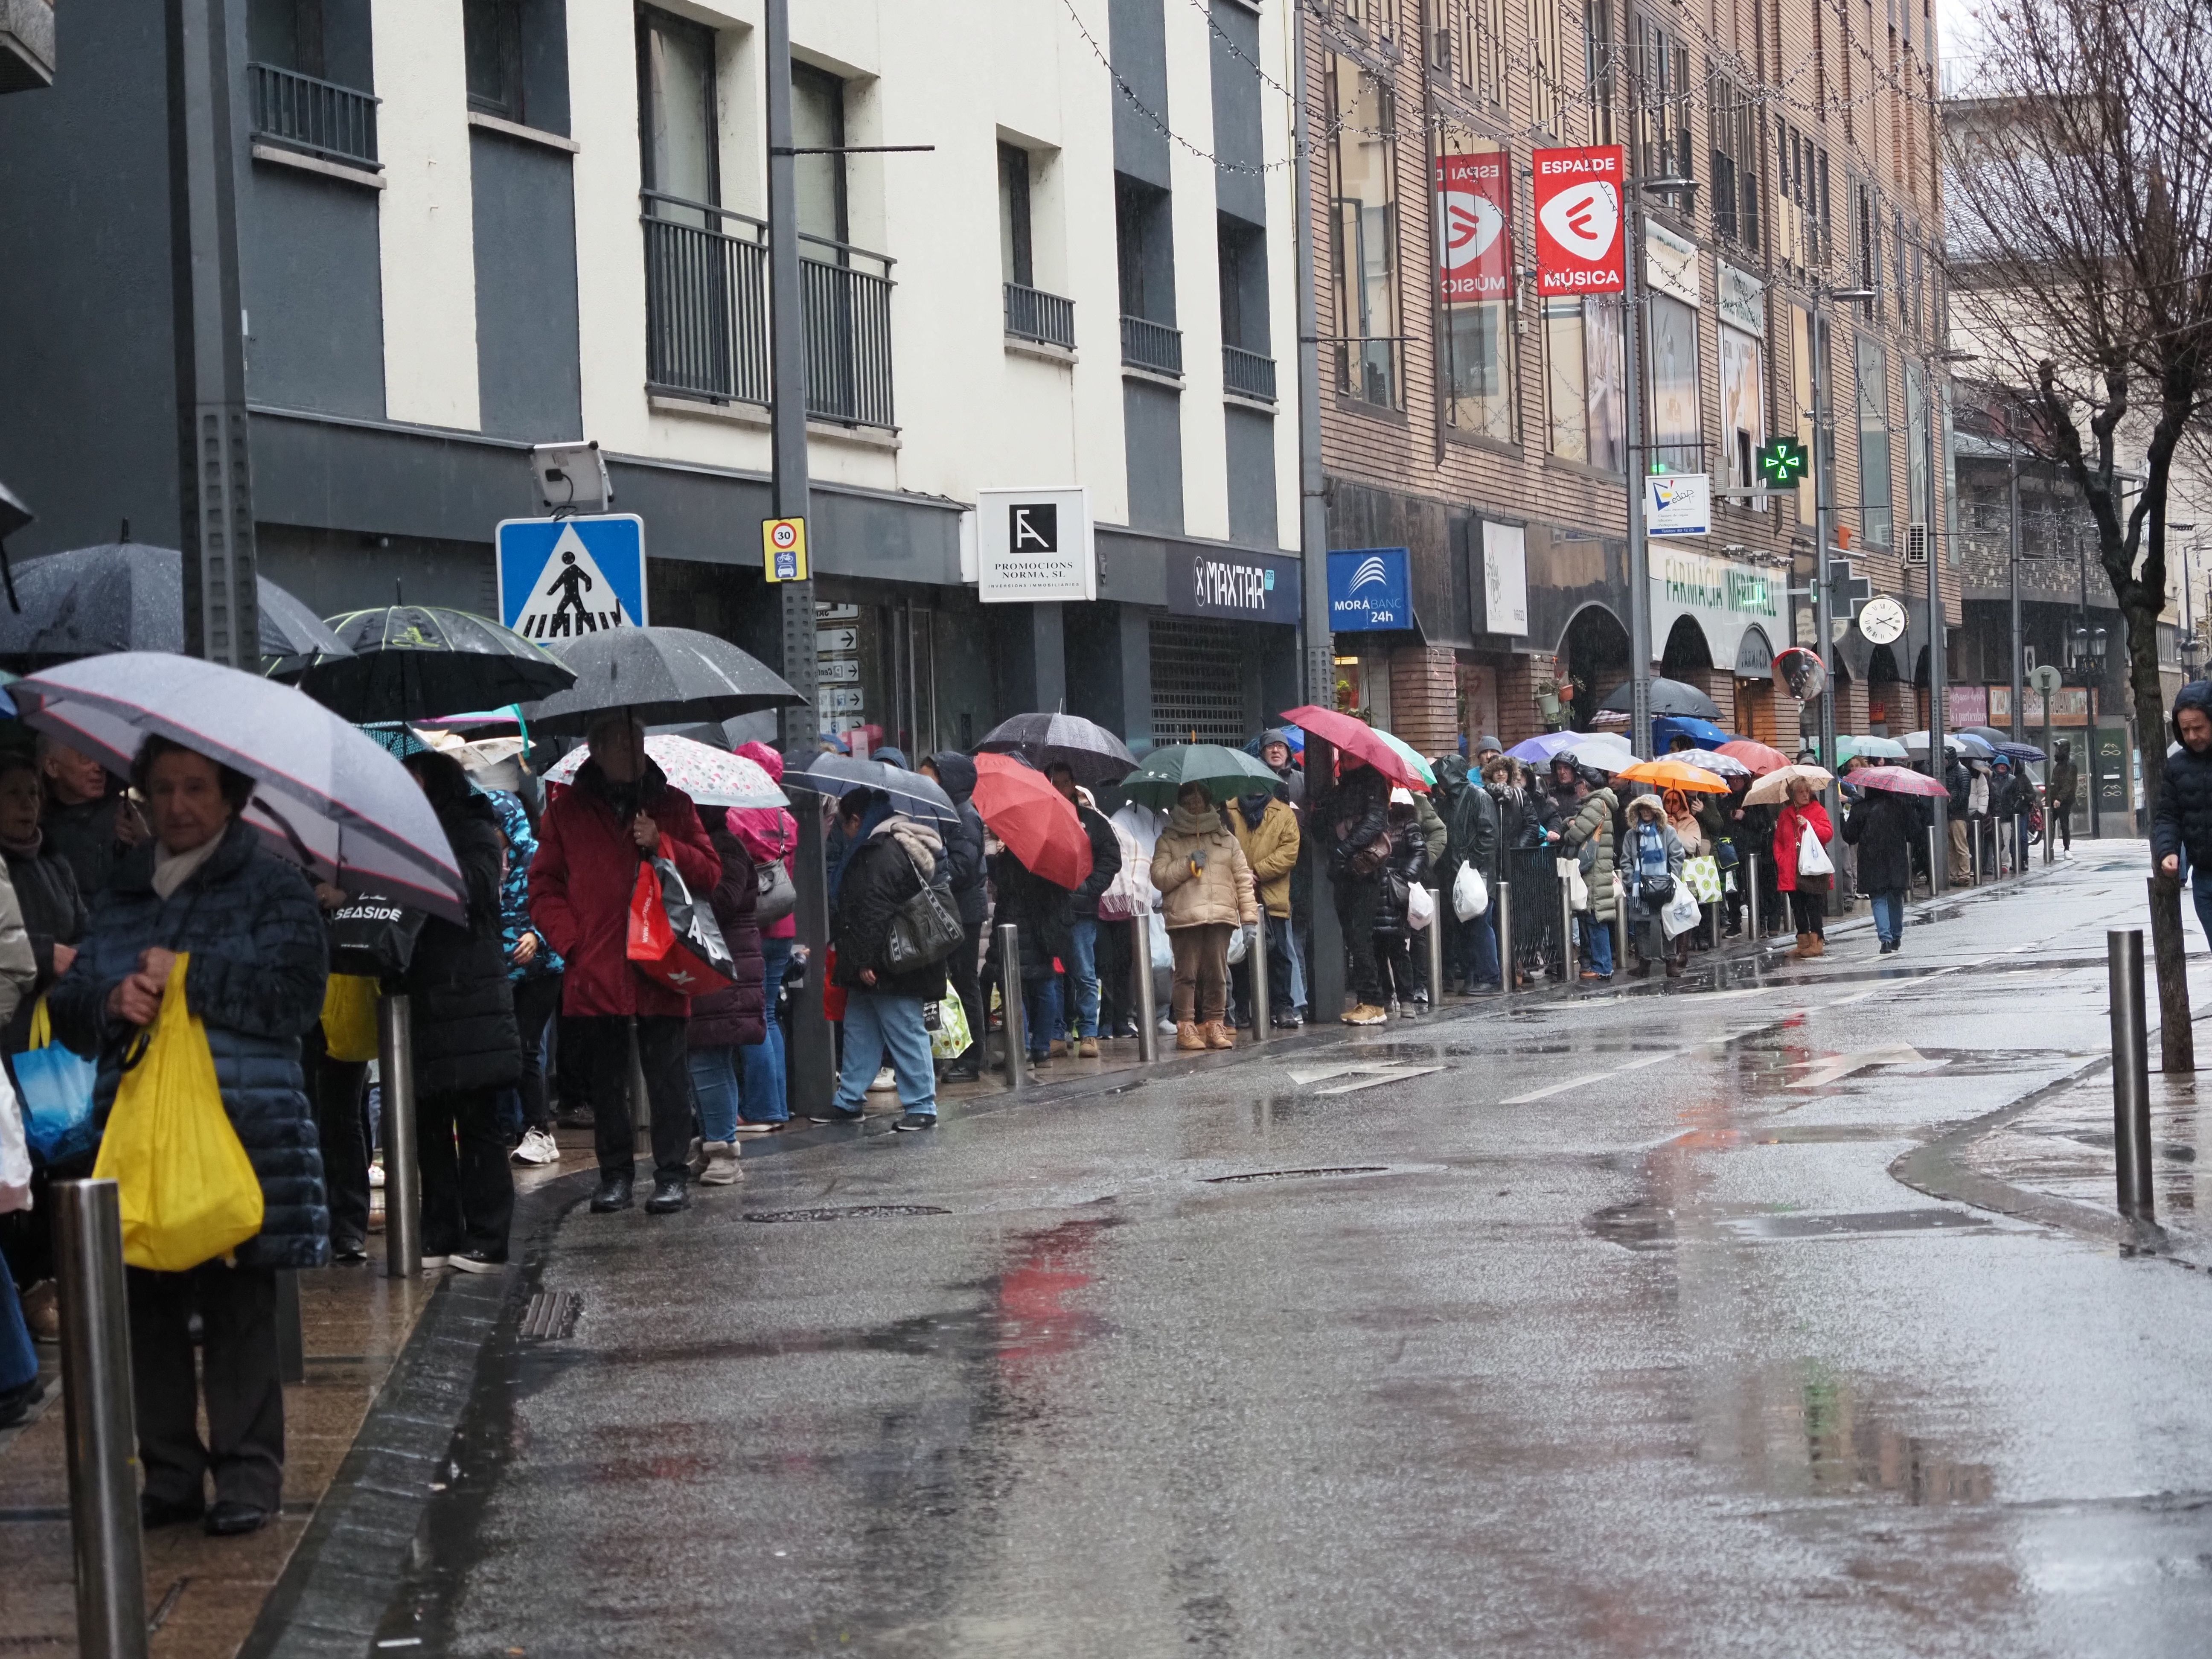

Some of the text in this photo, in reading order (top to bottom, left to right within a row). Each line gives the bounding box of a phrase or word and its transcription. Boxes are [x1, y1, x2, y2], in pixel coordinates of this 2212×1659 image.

[1542, 158, 1615, 174] ESPAI DE
[1544, 268, 1619, 287] MÚSICA
[777, 532, 791, 540] 30
[995, 562, 1073, 570] PROMOCIONS
[1206, 561, 1265, 609] MAXTAR
[1371, 611, 1393, 623] 24h
[335, 905, 402, 922] SEASIDE
